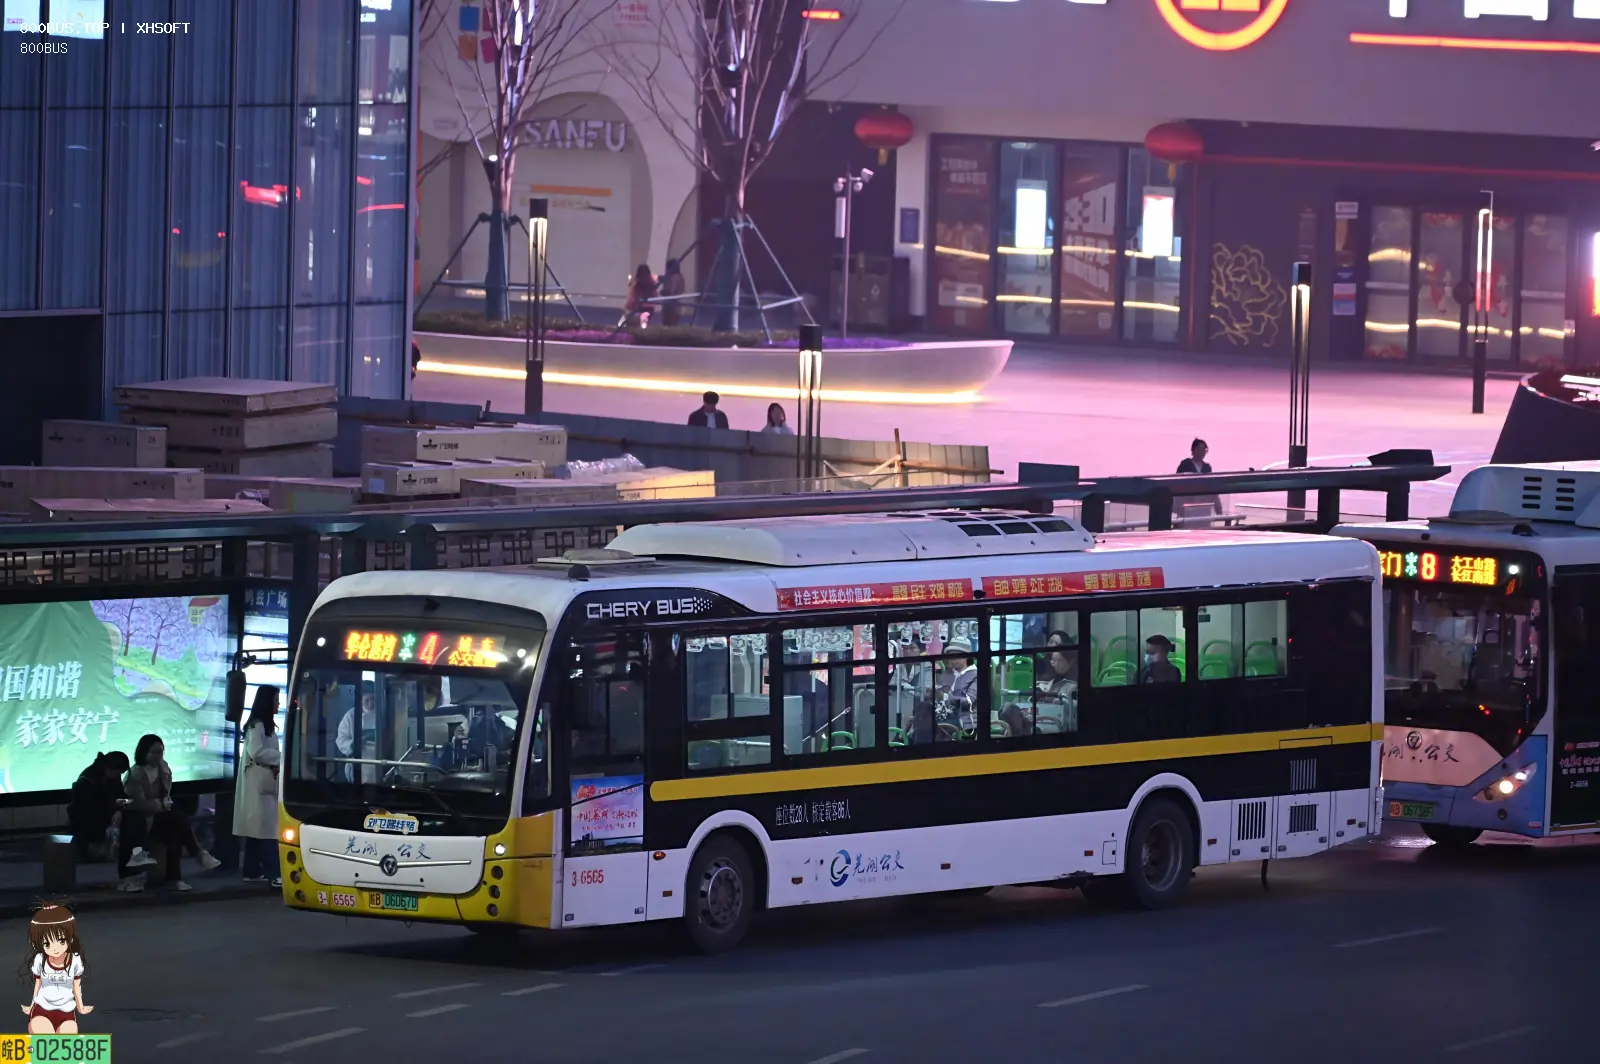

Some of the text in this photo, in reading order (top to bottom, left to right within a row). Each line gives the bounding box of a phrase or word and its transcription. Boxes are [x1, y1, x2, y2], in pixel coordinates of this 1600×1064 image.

[524, 119, 626, 152] SANFU
[1421, 552, 1436, 580] 8
[910, 583, 926, 601] 民主
[929, 582, 945, 600] 文明
[994, 579, 1010, 596] 自由
[1011, 578, 1027, 595] 平等
[1029, 577, 1045, 594] 公正
[1047, 576, 1063, 593] 法治
[1101, 572, 1116, 589] 敬业
[1118, 571, 1133, 588] 诚信
[586, 597, 694, 619] CHERY BUS
[420, 633, 438, 665] 4
[0, 660, 83, 702] 国和谐
[15, 705, 120, 748] 家家安宁
[1424, 743, 1460, 763] 公交
[775, 802, 809, 826] 座位数28人
[397, 842, 432, 860] 公交
[852, 849, 905, 877] 芜湖公交
[580, 869, 604, 885] 6565
[333, 893, 356, 907] 6565
